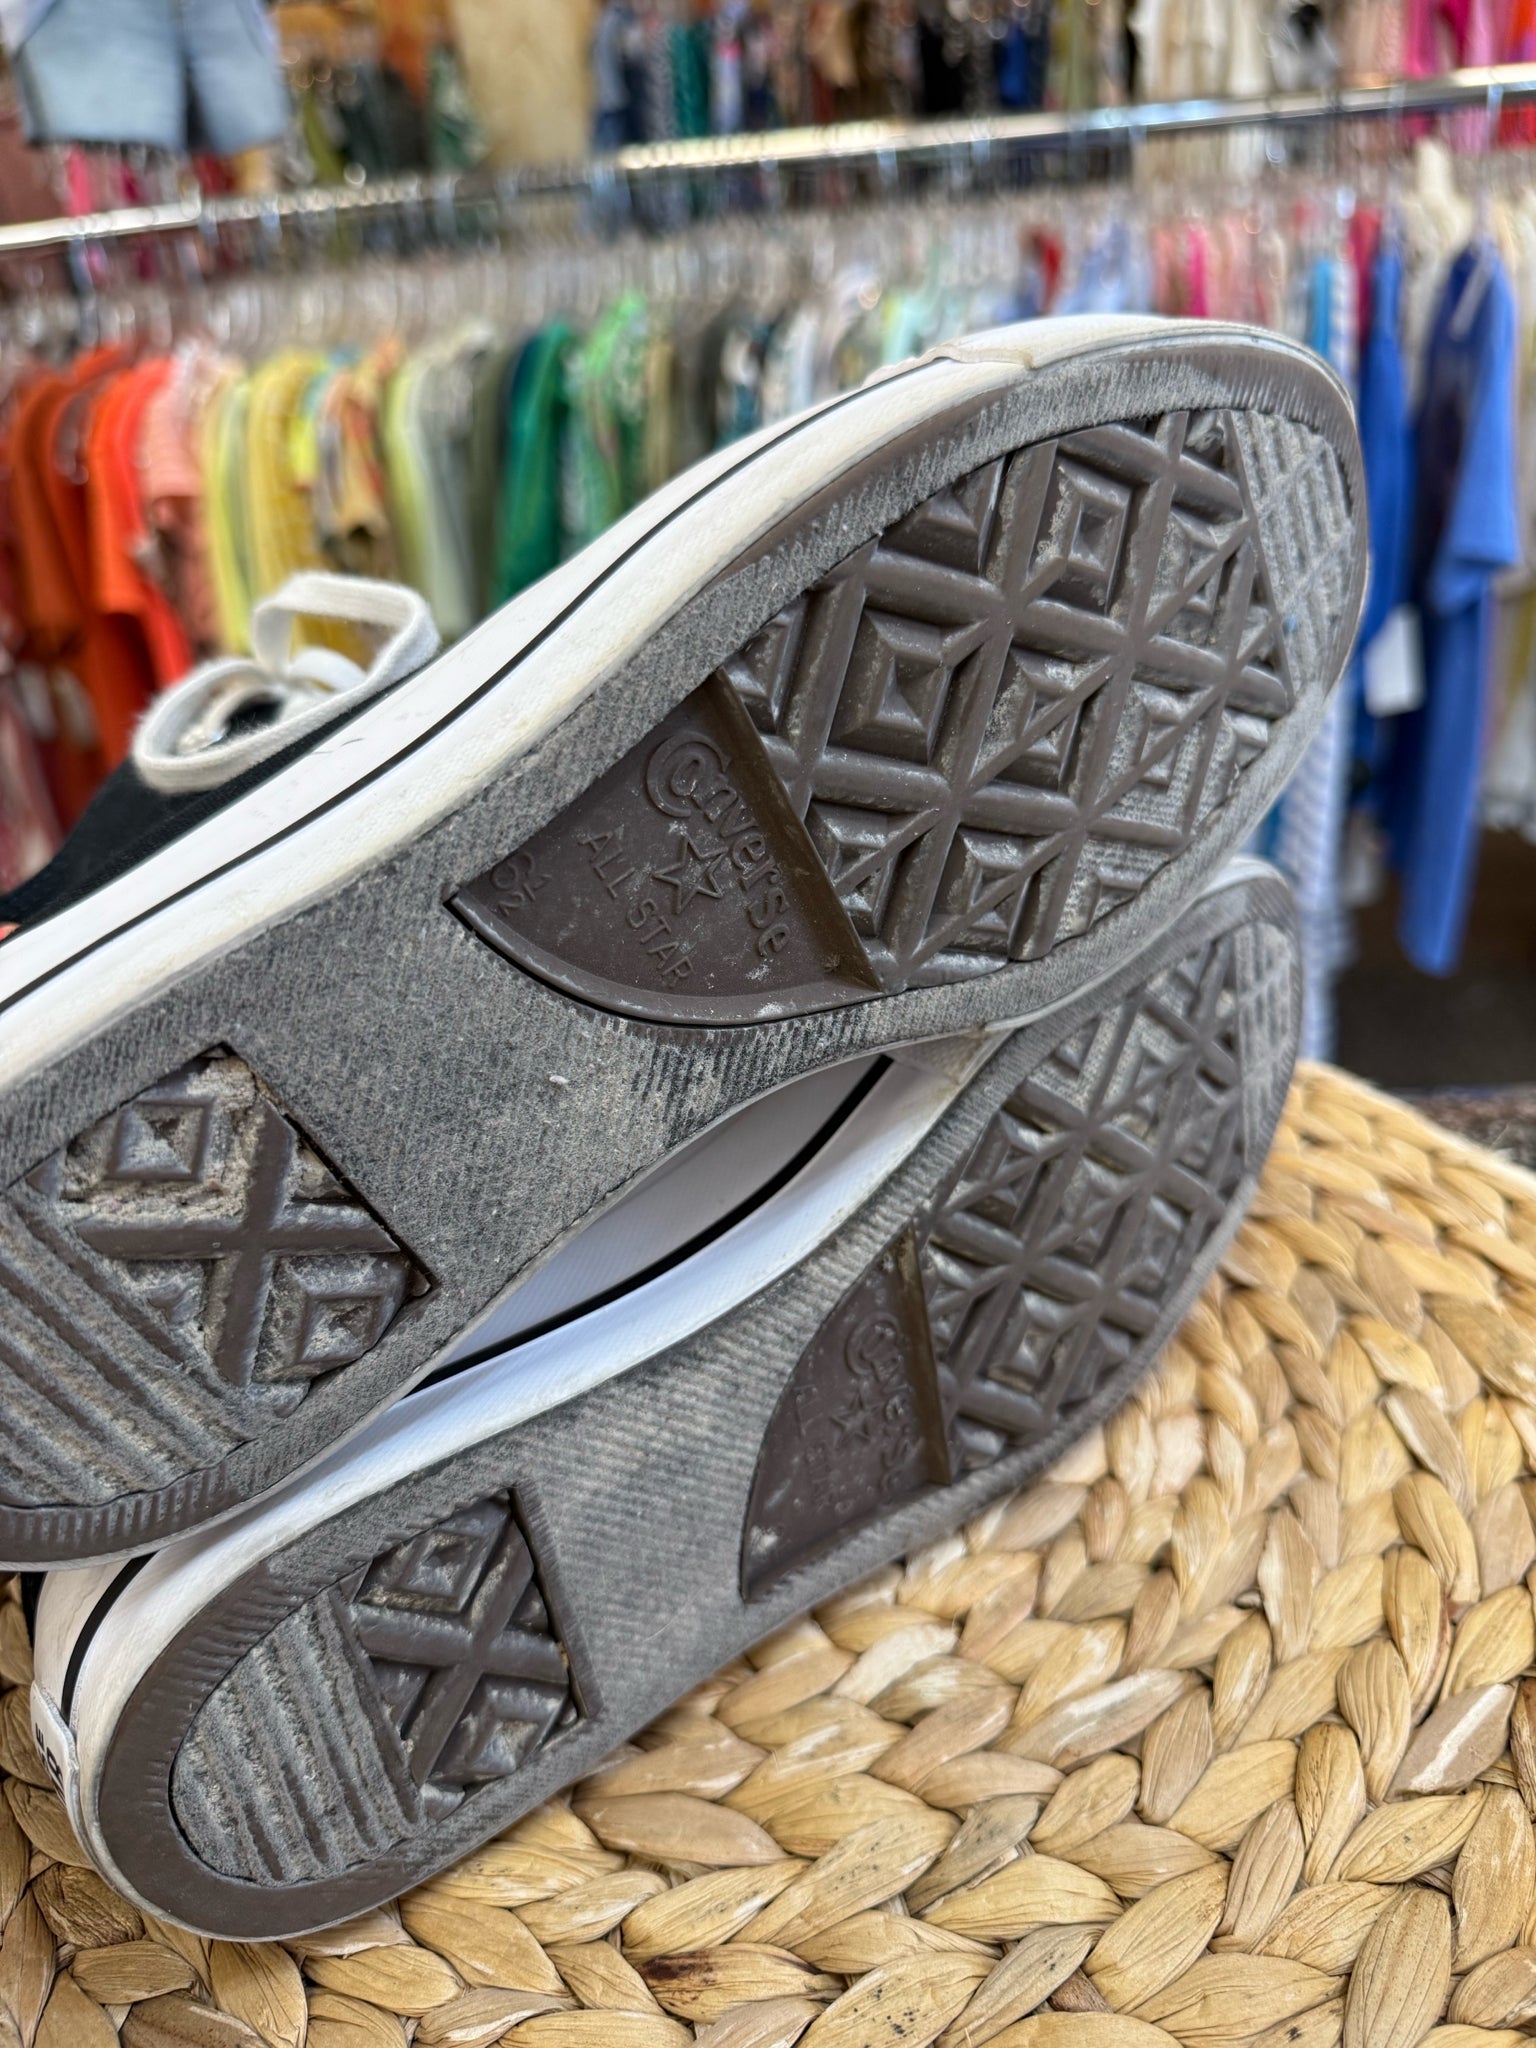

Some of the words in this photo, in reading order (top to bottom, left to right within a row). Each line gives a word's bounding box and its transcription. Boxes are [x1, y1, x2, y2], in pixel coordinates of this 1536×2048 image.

[577, 823, 636, 899] ALL
[625, 898, 696, 990] STAR
[645, 730, 790, 959] Converse
